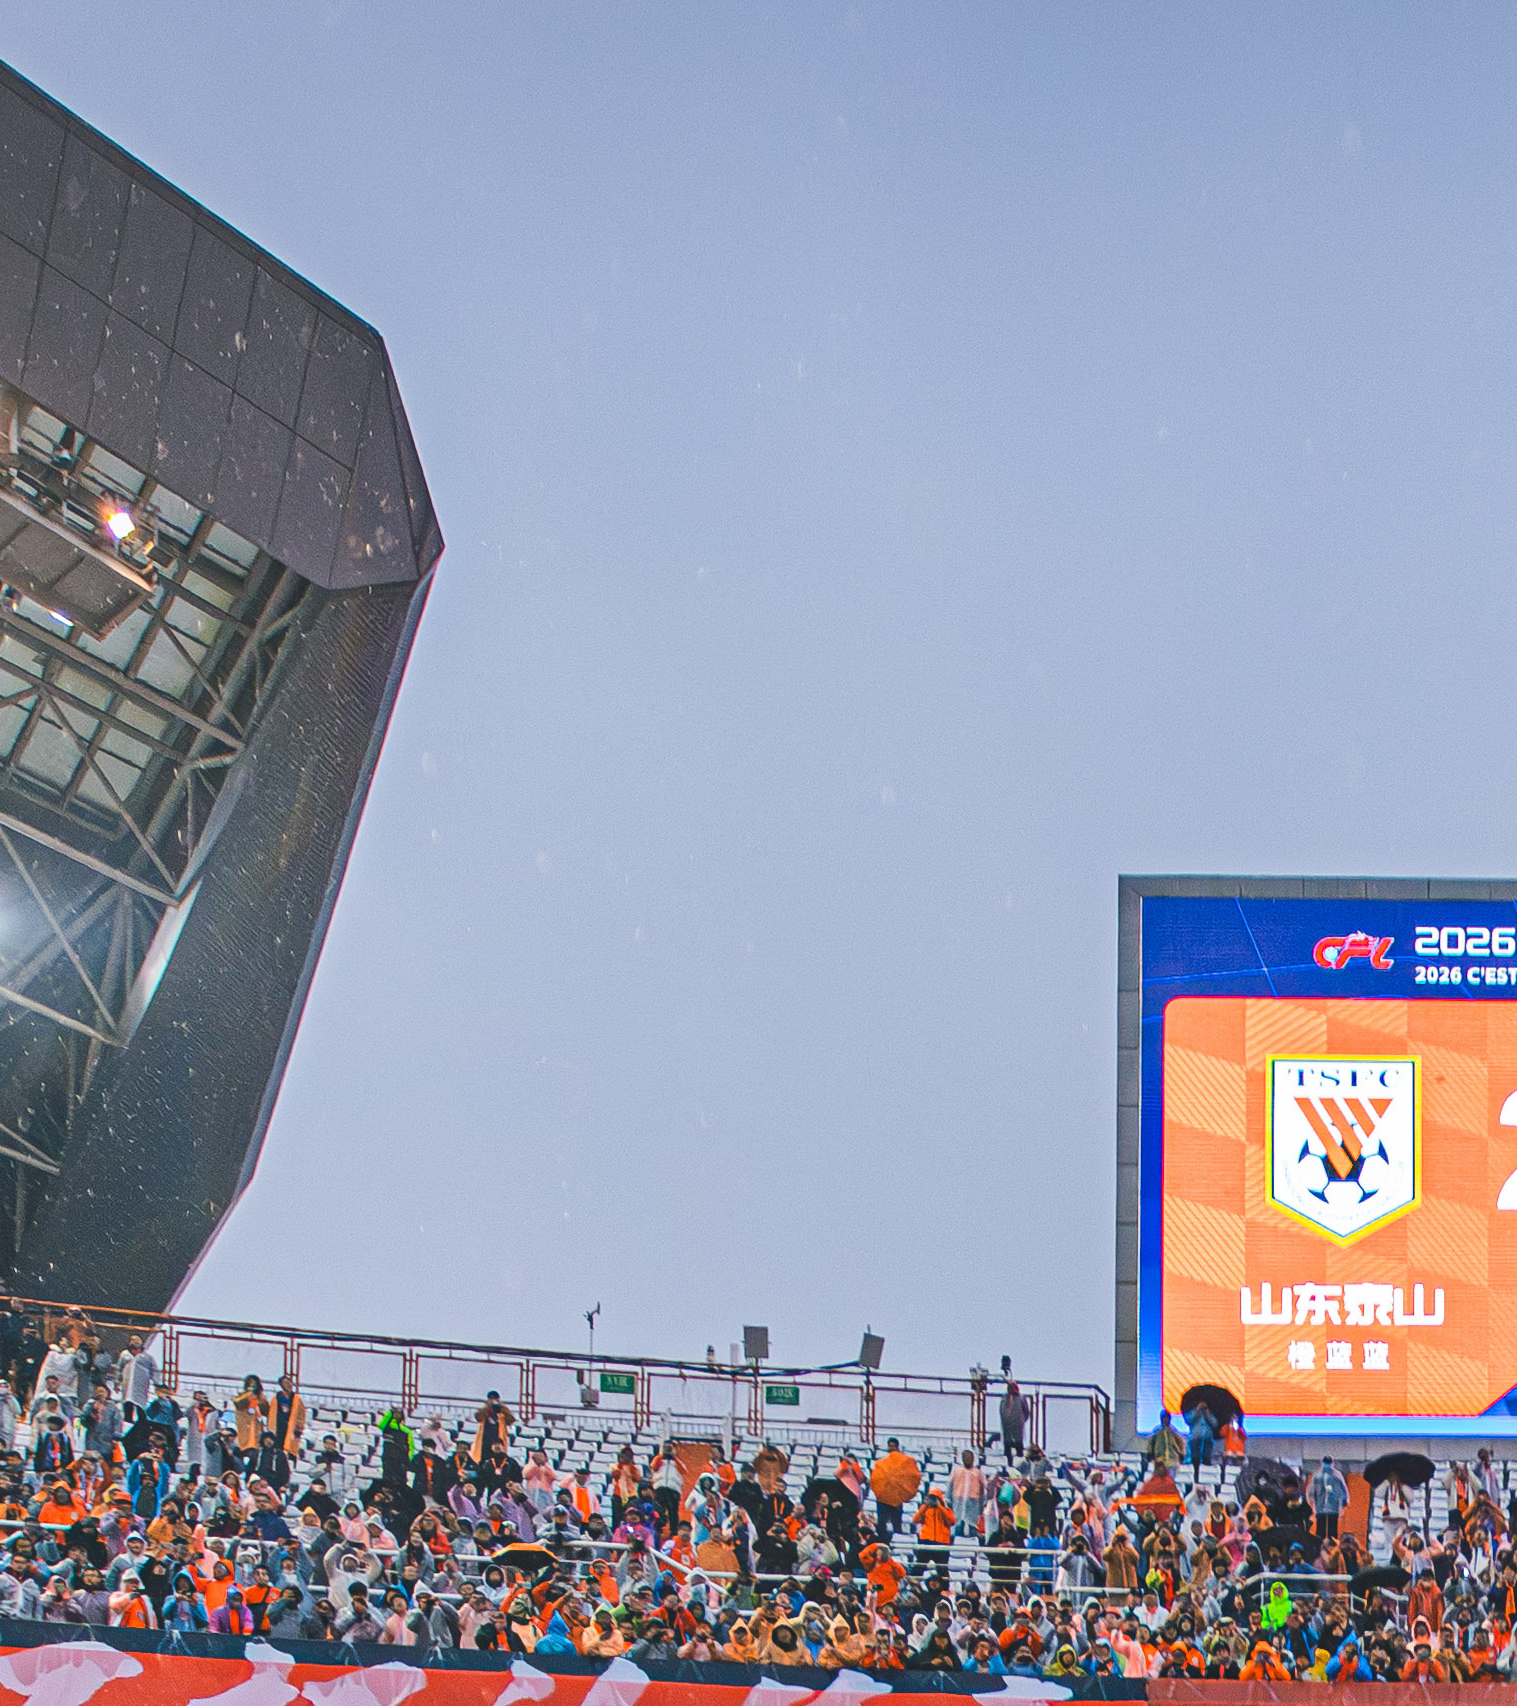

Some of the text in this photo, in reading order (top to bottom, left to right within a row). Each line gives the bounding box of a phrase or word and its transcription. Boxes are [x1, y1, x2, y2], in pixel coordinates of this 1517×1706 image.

[1414, 926, 1516, 957] 2026
[1414, 966, 1461, 984] 2026
[1241, 1281, 1444, 1326] 山东泰山
